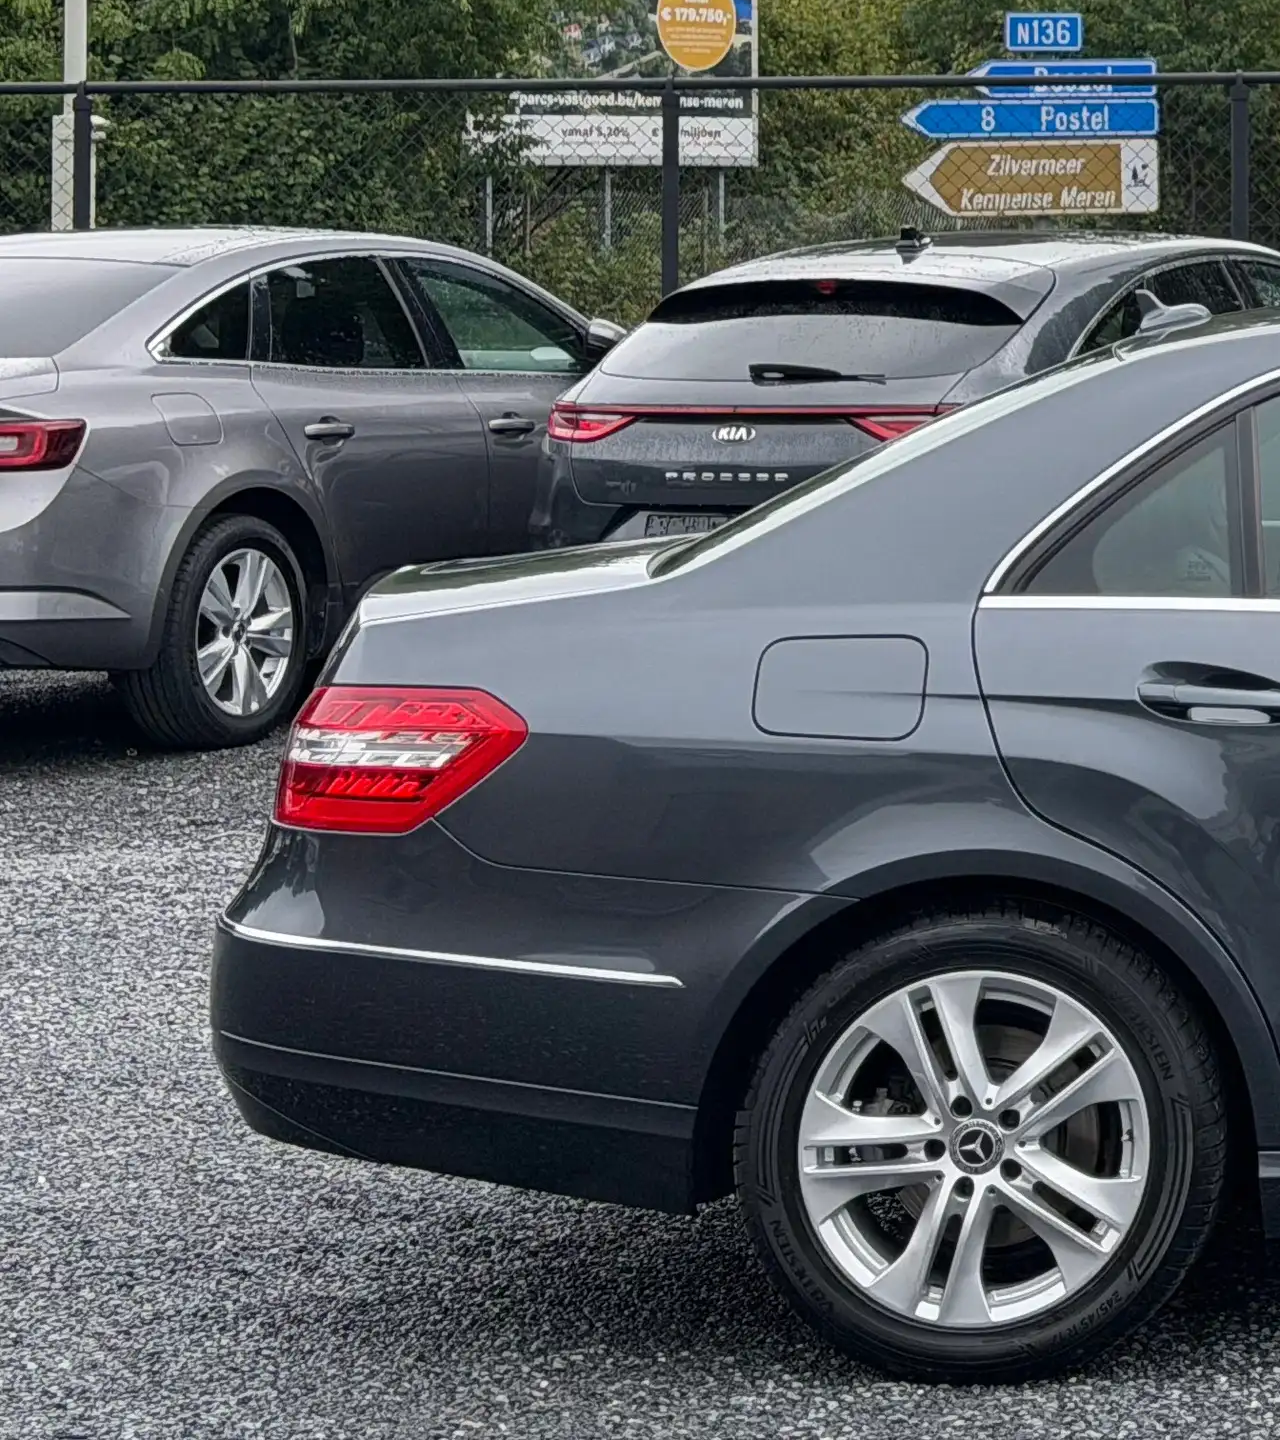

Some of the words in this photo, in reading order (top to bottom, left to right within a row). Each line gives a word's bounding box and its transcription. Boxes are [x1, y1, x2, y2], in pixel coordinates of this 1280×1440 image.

[1017, 20, 1071, 45] N136
[981, 106, 996, 132] 8
[1040, 105, 1109, 132] Postel
[986, 154, 1085, 177] Zilvermeer
[960, 187, 1053, 210] Kempense
[1060, 186, 1116, 209] Meren
[717, 426, 748, 441] KIA
